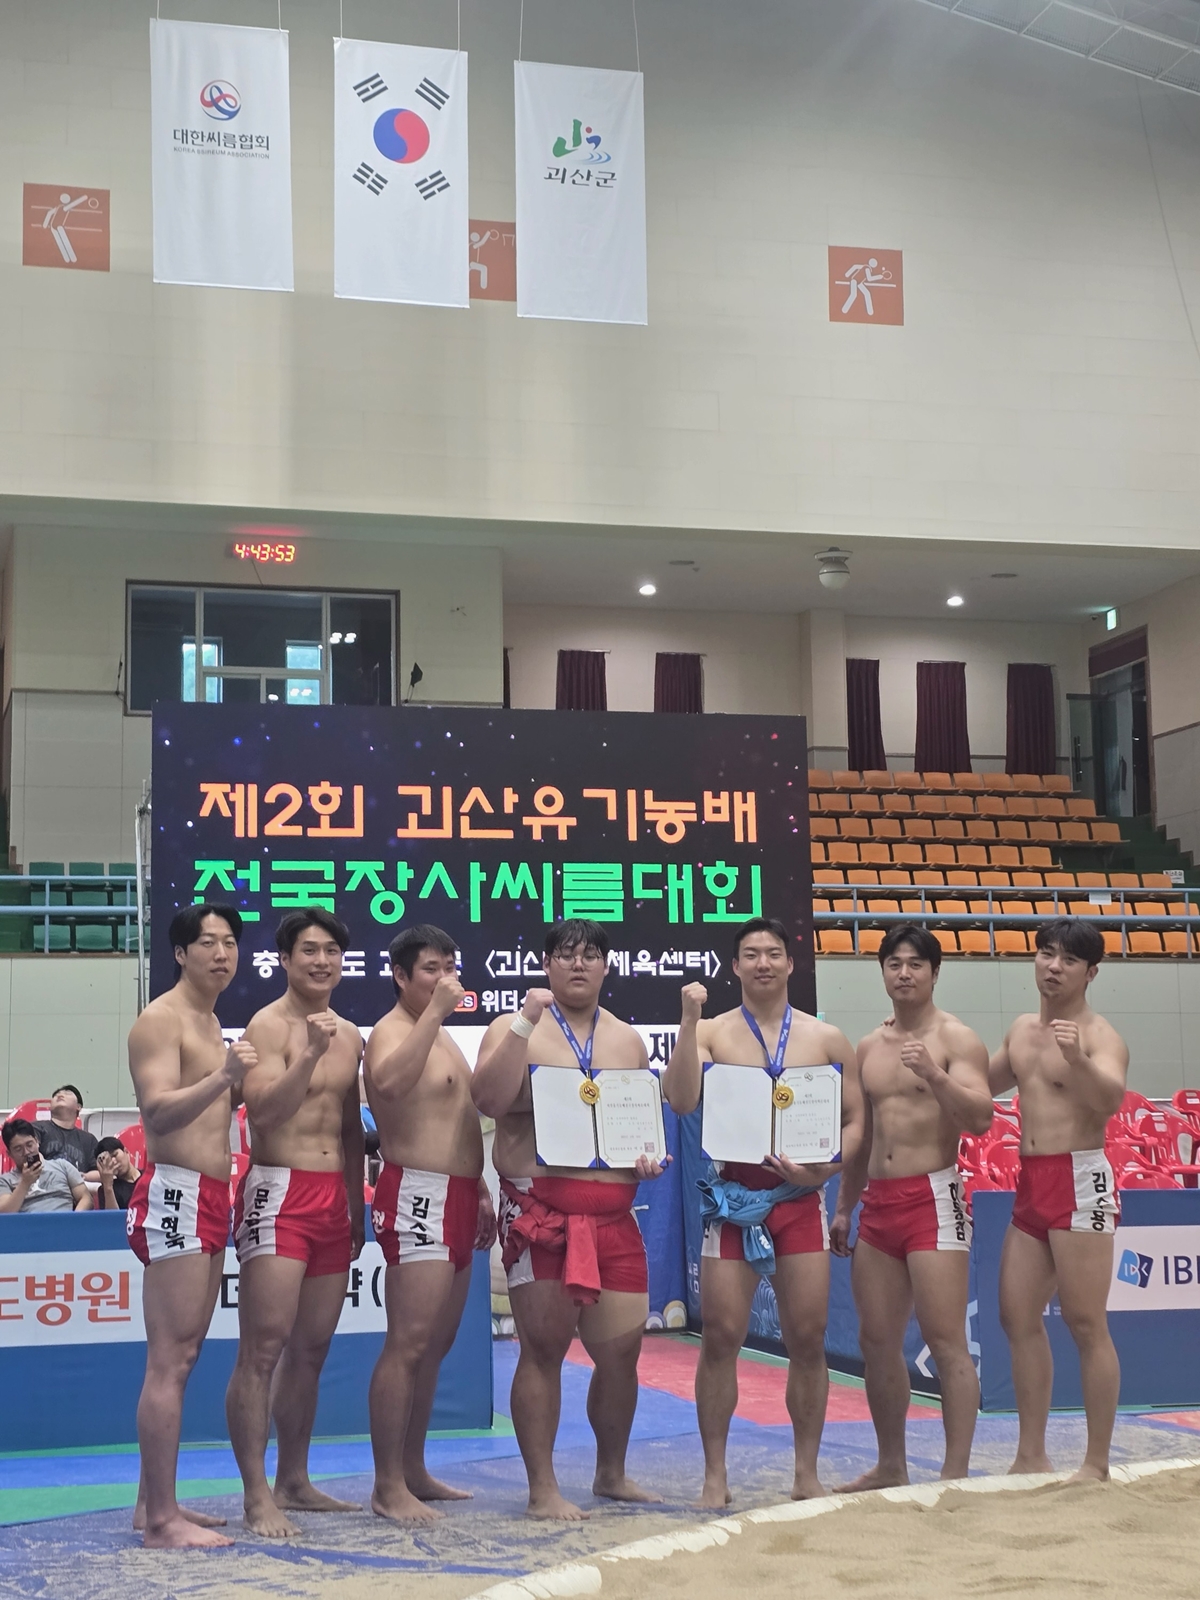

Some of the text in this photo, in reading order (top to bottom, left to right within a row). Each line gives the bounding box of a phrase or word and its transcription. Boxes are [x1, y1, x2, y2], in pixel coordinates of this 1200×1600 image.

[173, 128, 270, 151] 대한씨름협회
[173, 146, 196, 154] KOREA
[227, 150, 270, 159] ASSOCIATION
[544, 166, 617, 188] 괴산군
[234, 543, 295, 562] 4:43:53
[199, 780, 758, 844] 제2회 괴산유기농배
[193, 860, 763, 924] 전국장사씨름대회
[1163, 1255, 1200, 1285] IB
